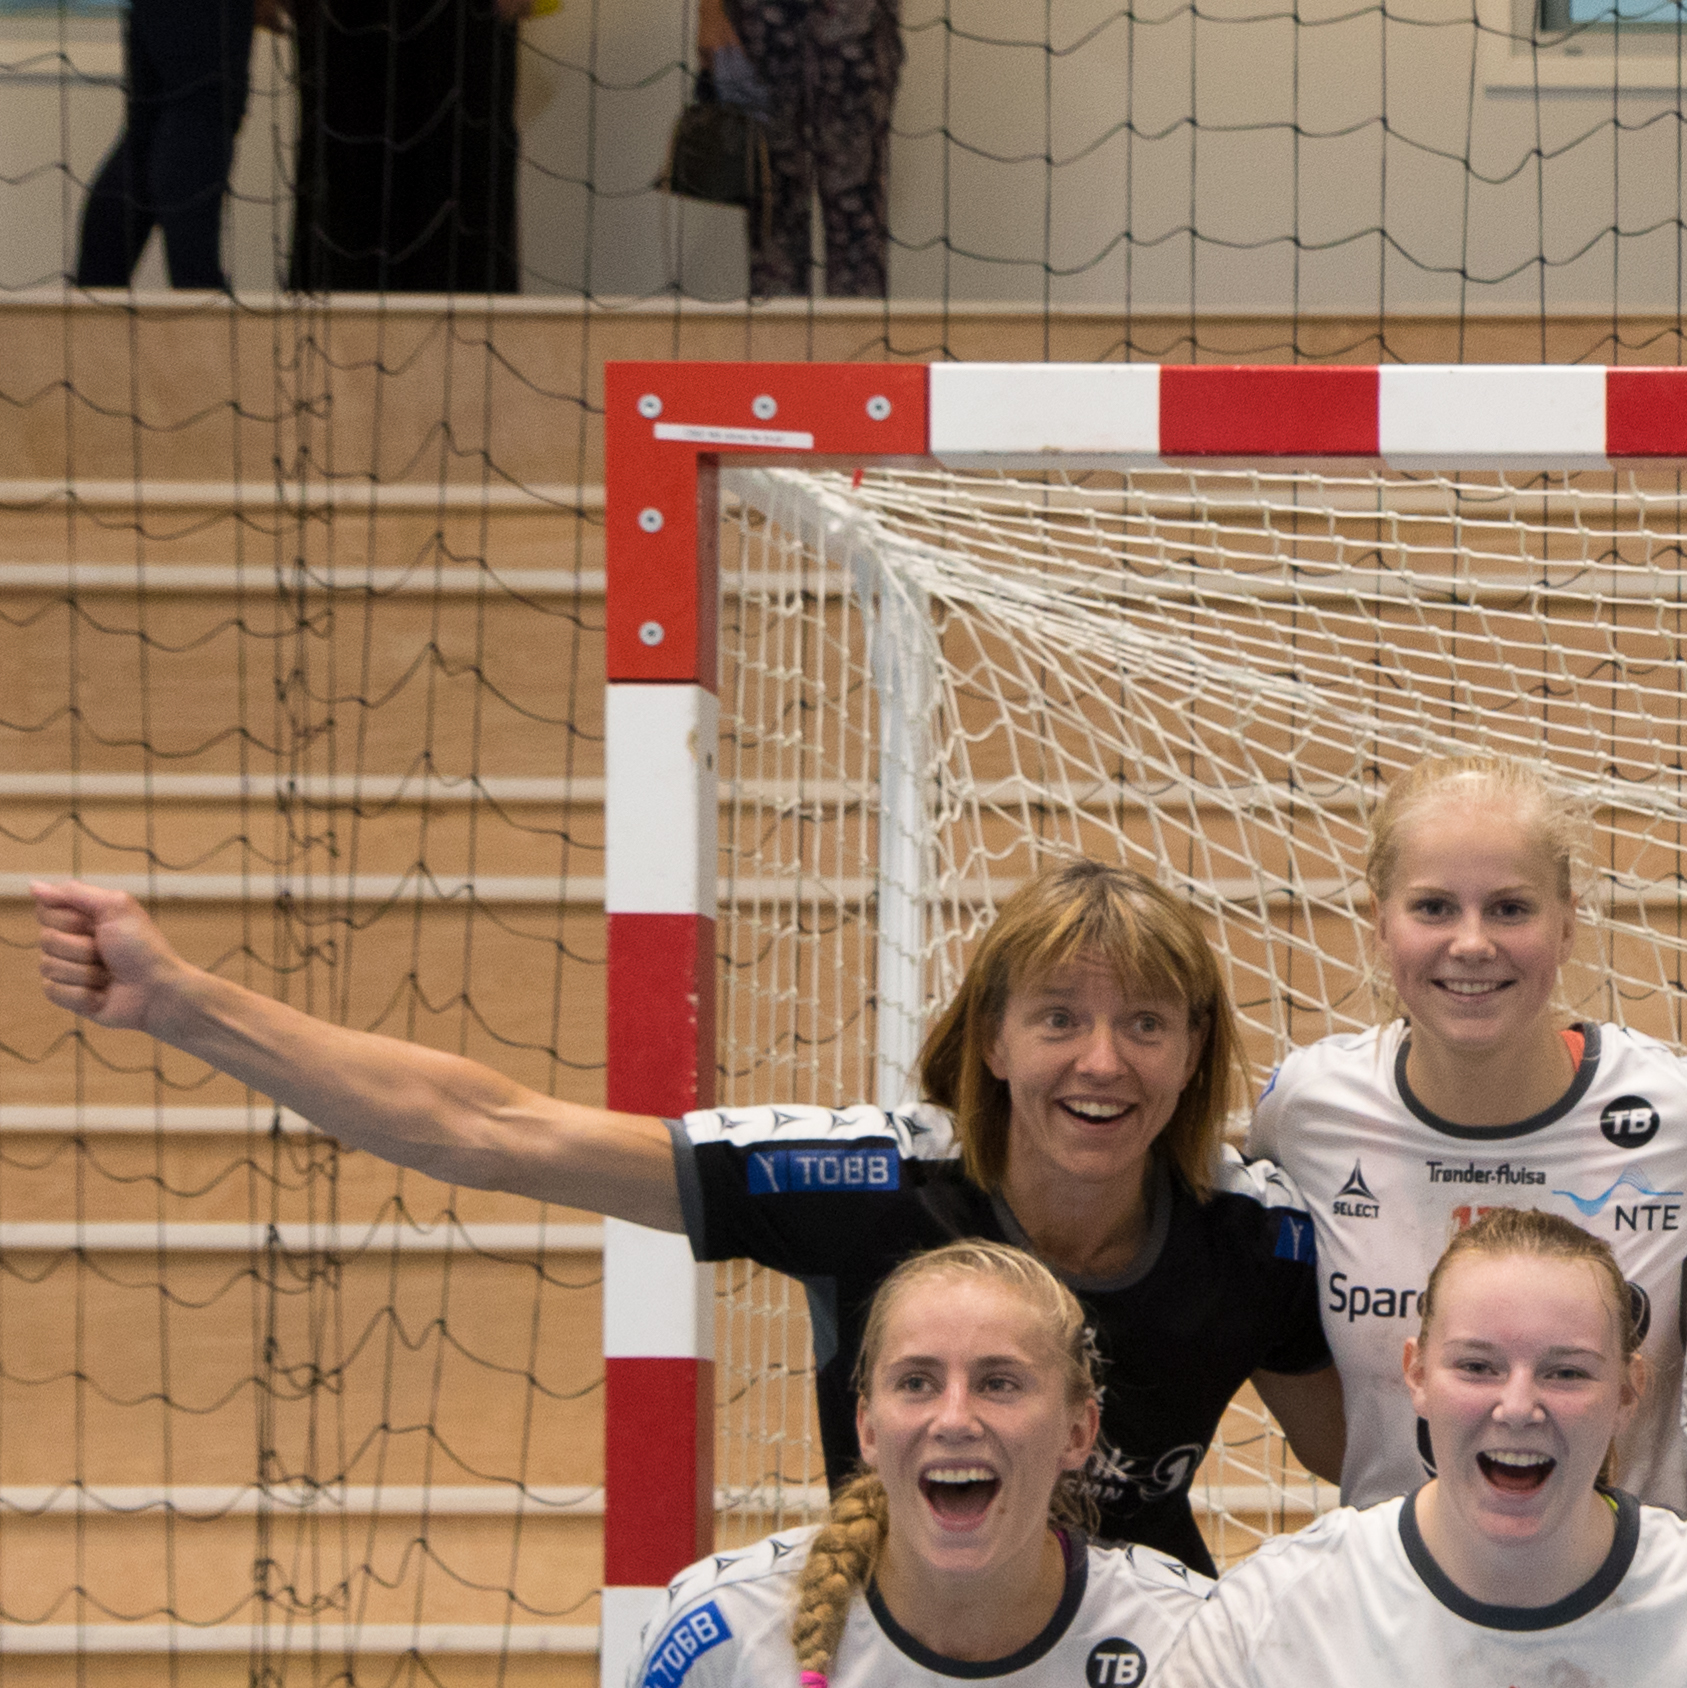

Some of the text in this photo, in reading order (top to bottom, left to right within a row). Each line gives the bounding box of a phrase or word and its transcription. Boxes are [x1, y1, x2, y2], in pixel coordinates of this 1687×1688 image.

[1607, 1106, 1652, 1134] TB
[795, 1154, 890, 1185] TOBB
[1332, 1200, 1380, 1219] SELECT
[1614, 1204, 1681, 1231] NTE
[652, 1610, 720, 1683] TOBB
[1095, 1653, 1139, 1685] TB
